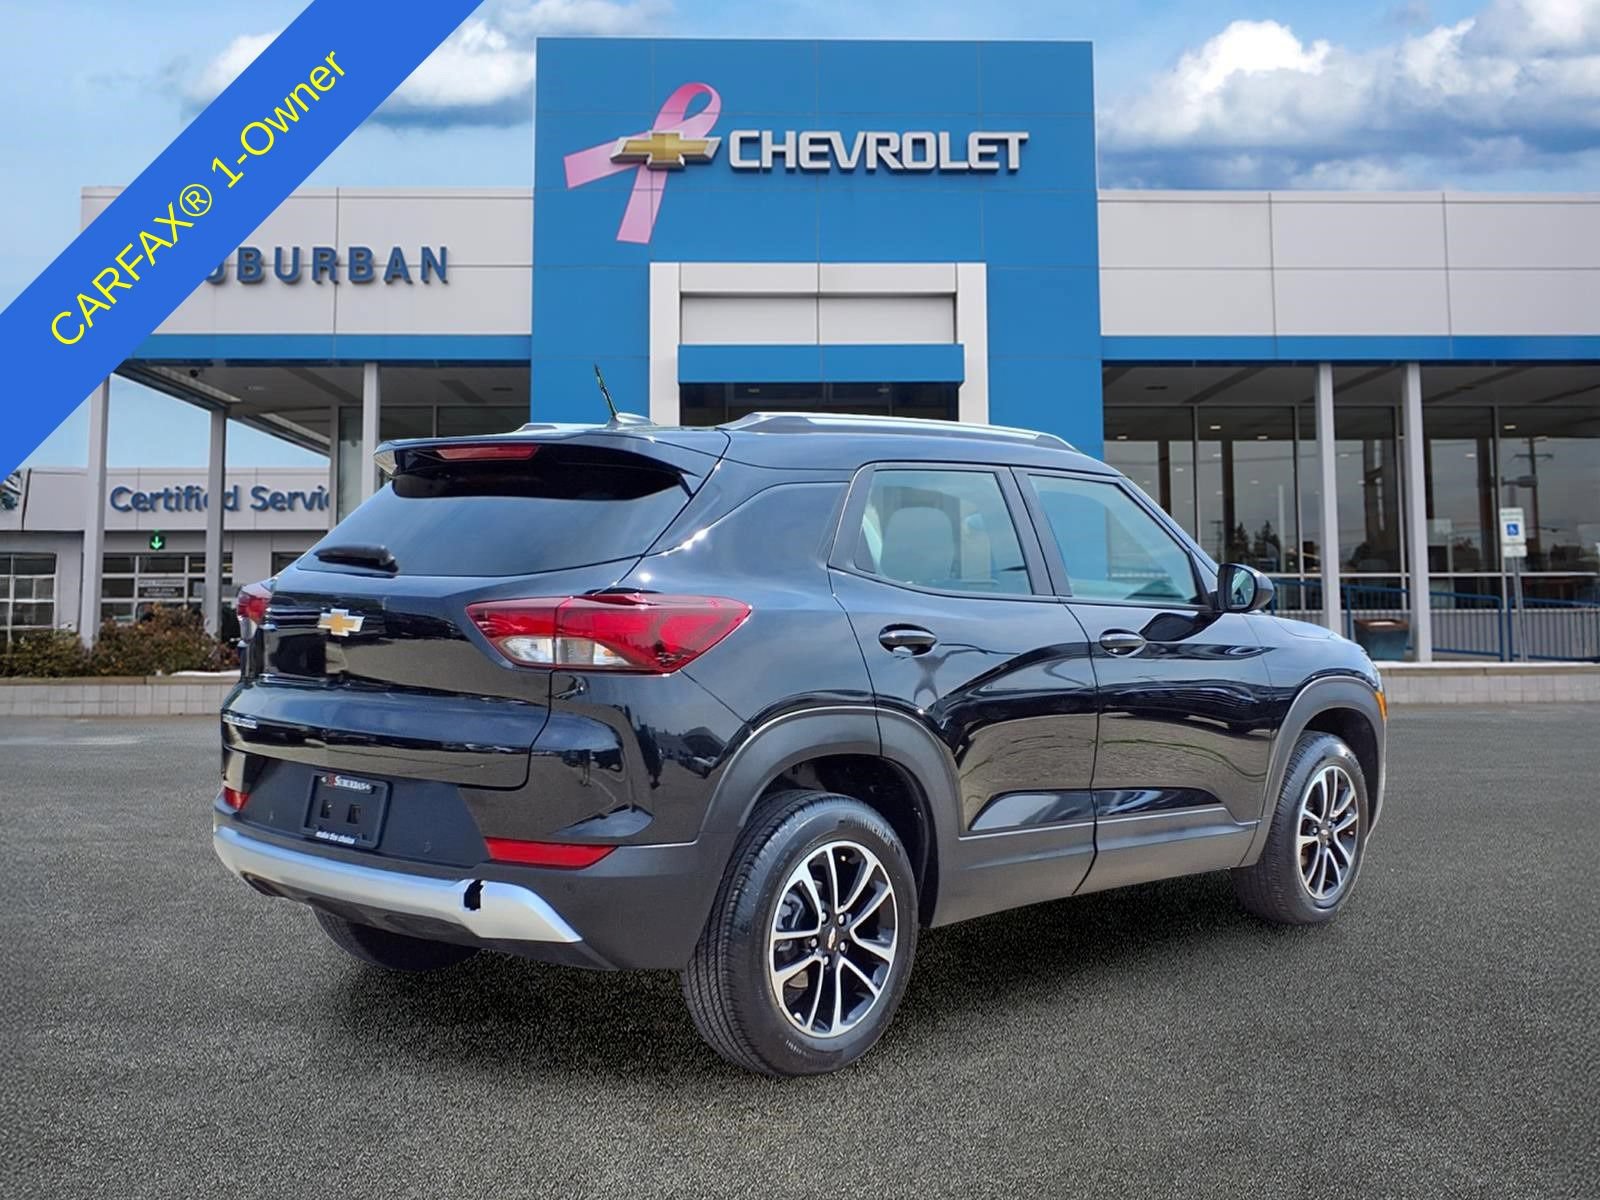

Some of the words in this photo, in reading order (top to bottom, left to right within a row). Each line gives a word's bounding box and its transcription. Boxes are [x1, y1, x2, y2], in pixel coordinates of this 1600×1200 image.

[728, 130, 1029, 171] CHEVROLET
[110, 485, 240, 512] Certifid
[250, 485, 330, 512] Servi
